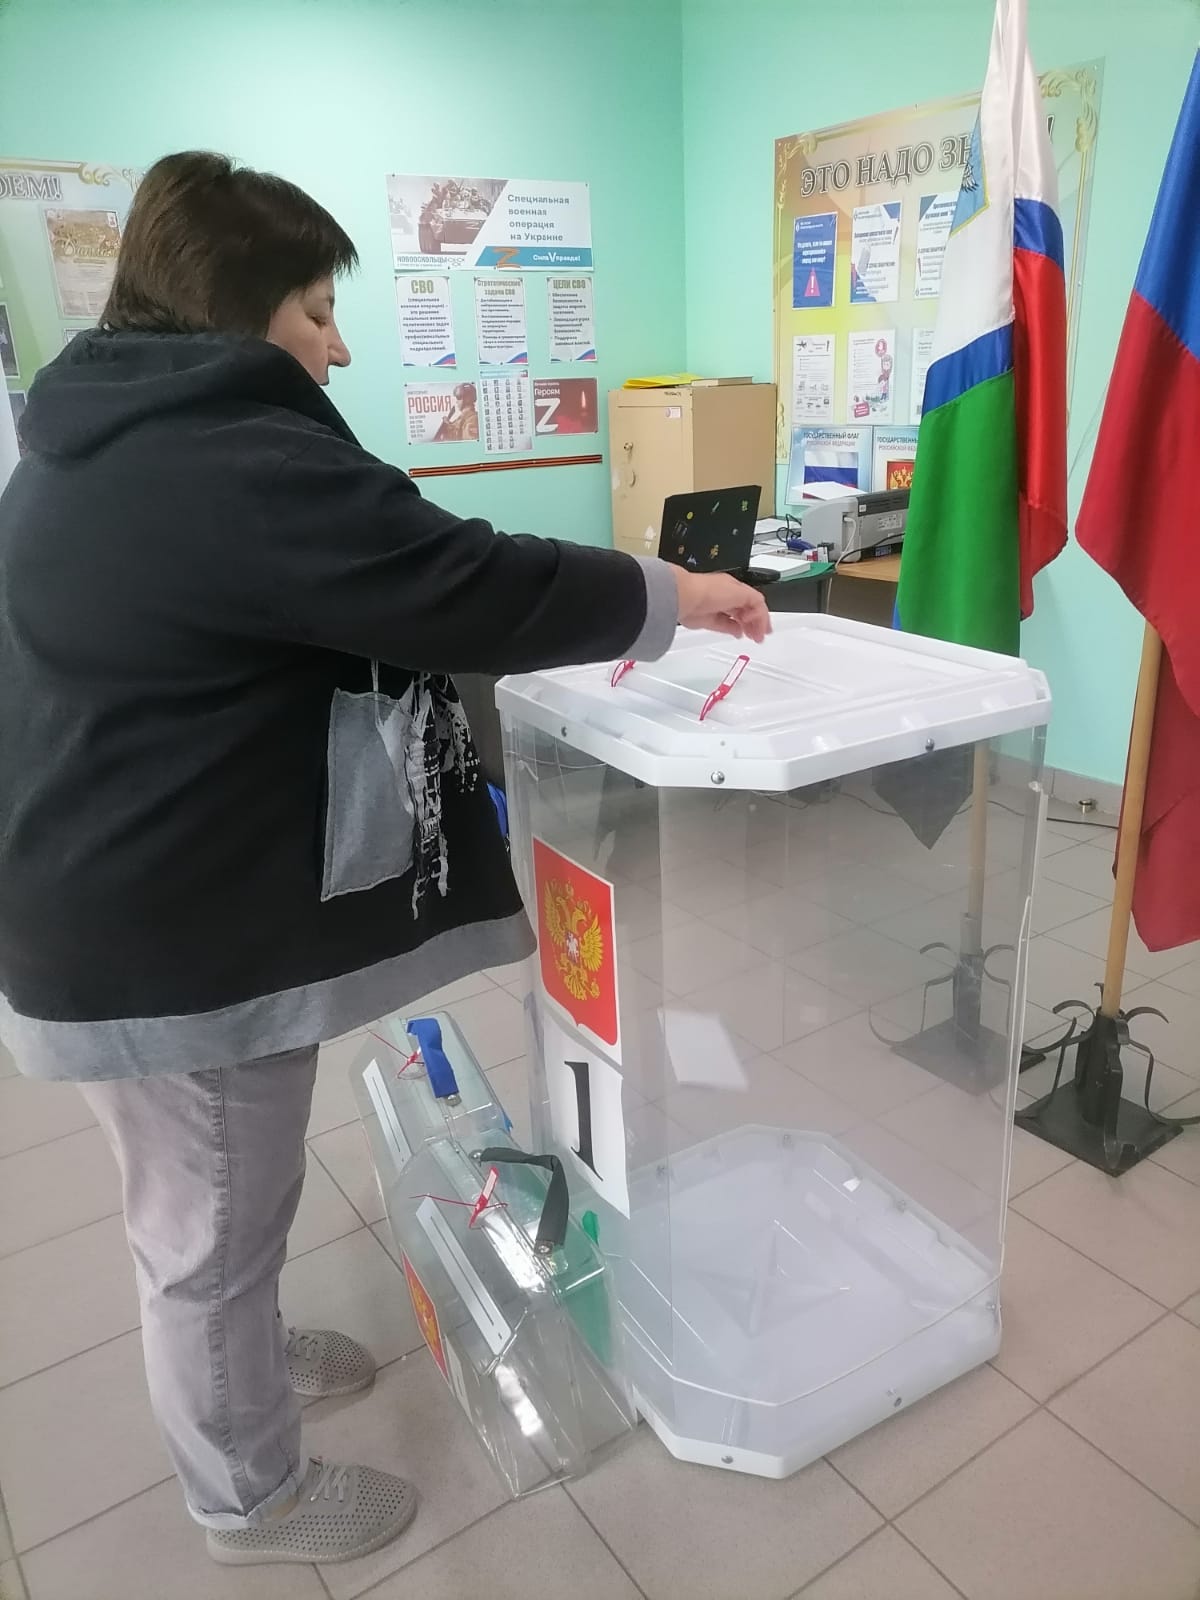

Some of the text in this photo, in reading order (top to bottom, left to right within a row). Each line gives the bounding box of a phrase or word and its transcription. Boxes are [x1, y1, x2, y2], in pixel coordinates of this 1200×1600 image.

[801, 162, 850, 197] ЭТО
[856, 144, 934, 187] НАДО
[507, 194, 570, 205] Специальная
[508, 207, 547, 216] военная
[509, 220, 555, 230] операция
[510, 232, 563, 242] на Украине
[411, 279, 434, 294] СВО
[553, 279, 586, 289] ЦЕЛИ СВО
[505, 288, 515, 296] СВО
[534, 388, 560, 397] Героям
[407, 395, 452, 414] РОССИЯ
[535, 398, 560, 433] Z
[564, 1060, 604, 1182] 1
